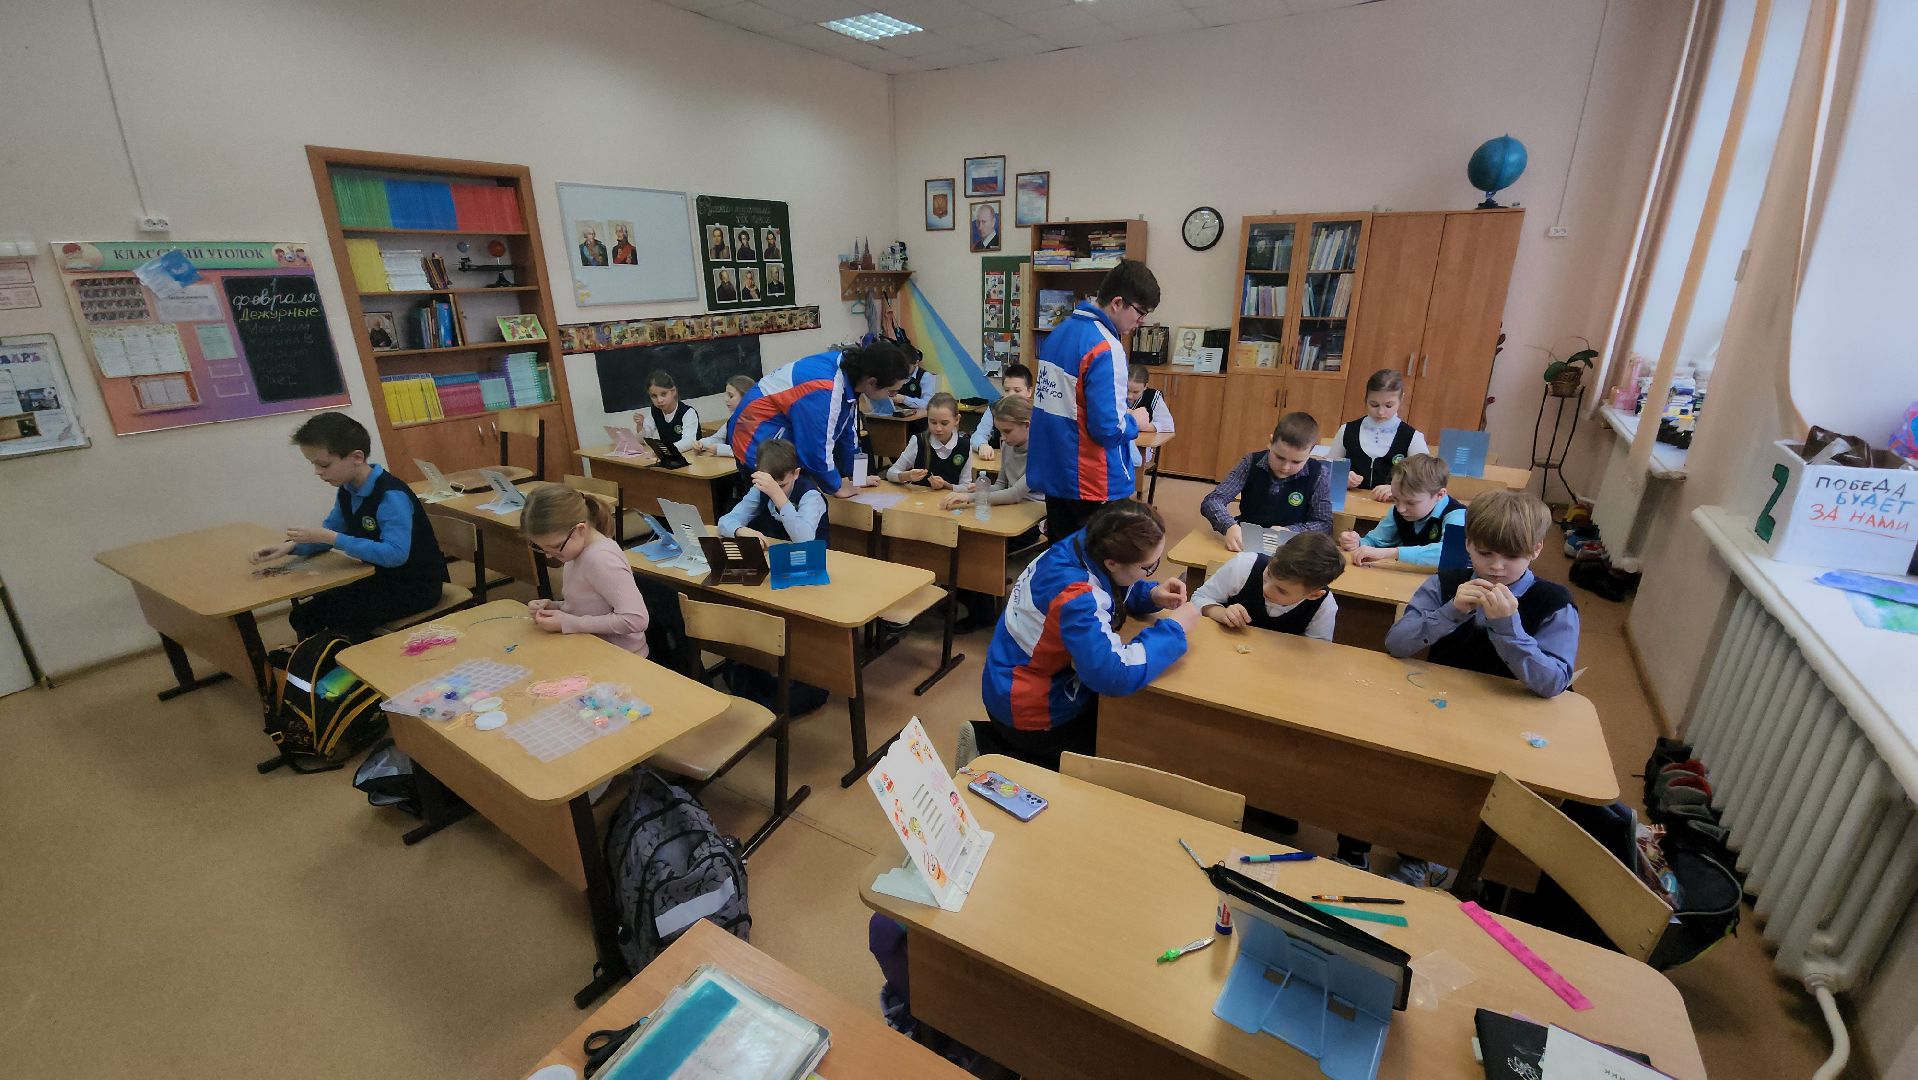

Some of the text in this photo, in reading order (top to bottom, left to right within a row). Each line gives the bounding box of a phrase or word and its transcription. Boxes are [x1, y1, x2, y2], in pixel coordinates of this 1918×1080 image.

[112, 247, 264, 260] КЛАССЫЙ УГОЛОК
[232, 288, 317, 311] февраля
[239, 307, 320, 323] Дежурные
[1815, 476, 1907, 499] ПОБЕДА
[1836, 491, 1915, 515] БУДЕТ
[1809, 503, 1909, 533] ЗА НАМИ
